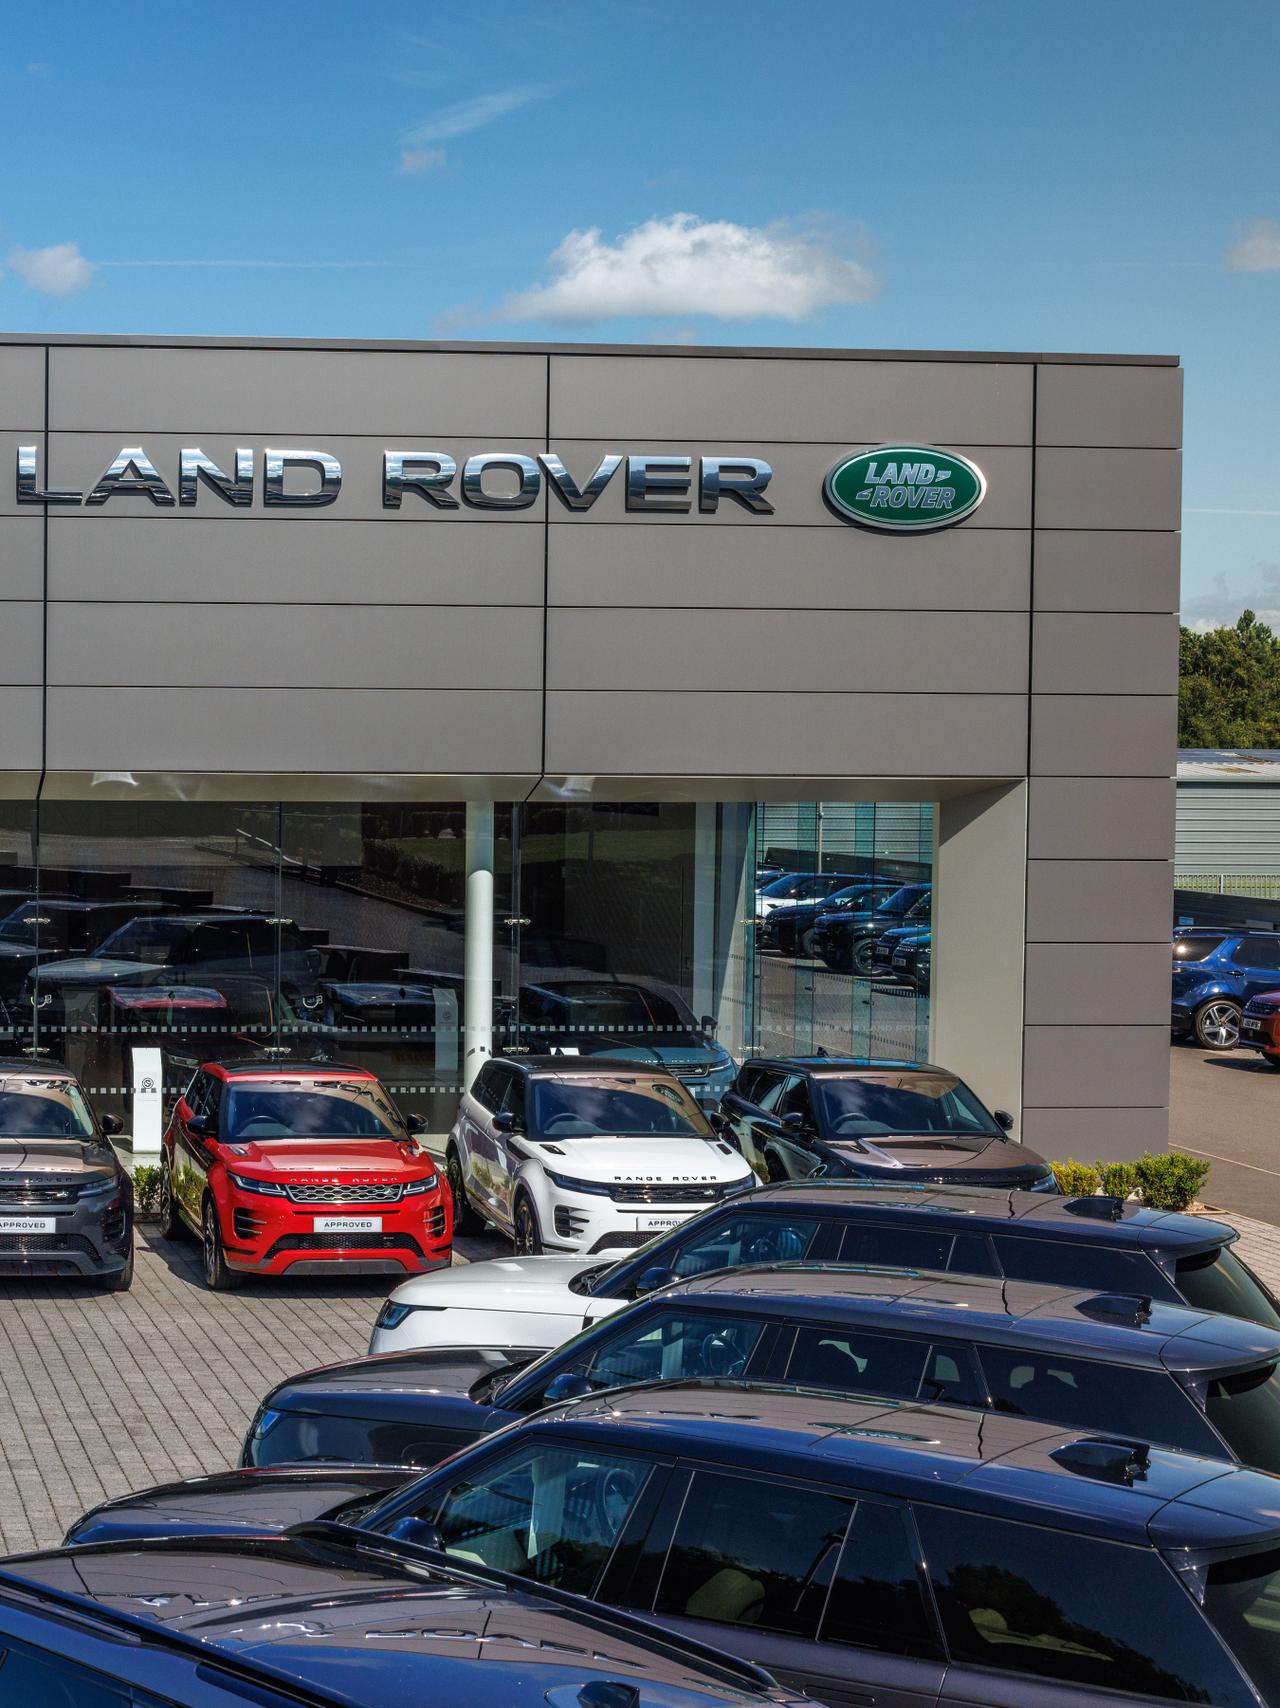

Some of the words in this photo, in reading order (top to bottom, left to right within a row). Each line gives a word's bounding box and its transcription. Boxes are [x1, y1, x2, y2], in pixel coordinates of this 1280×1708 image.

[16, 446, 342, 508] LAND
[383, 450, 776, 515] ROVER
[864, 462, 935, 485] LAND
[870, 485, 956, 509] ROVER
[323, 1220, 373, 1228] APPROVED
